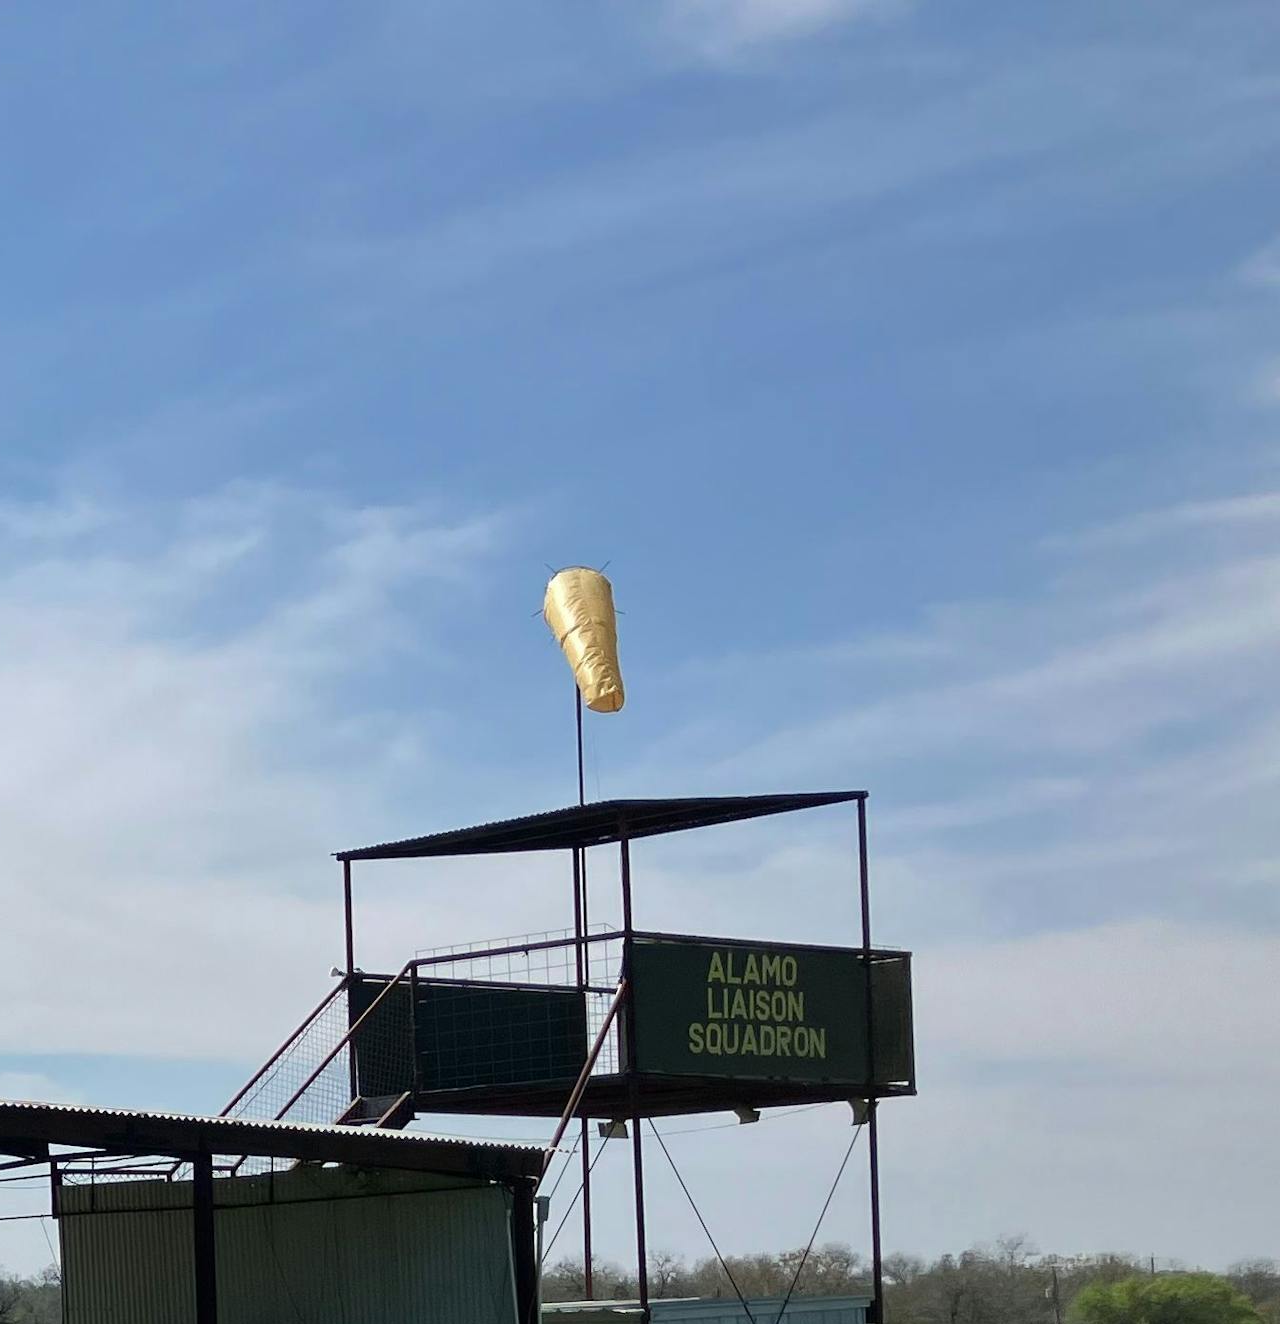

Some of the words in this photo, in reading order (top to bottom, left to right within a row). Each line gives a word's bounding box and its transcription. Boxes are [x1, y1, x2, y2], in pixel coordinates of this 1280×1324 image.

[707, 951, 798, 987] ALAMO
[707, 988, 804, 1022] LIAISON
[689, 1023, 826, 1058] SQUADRON
